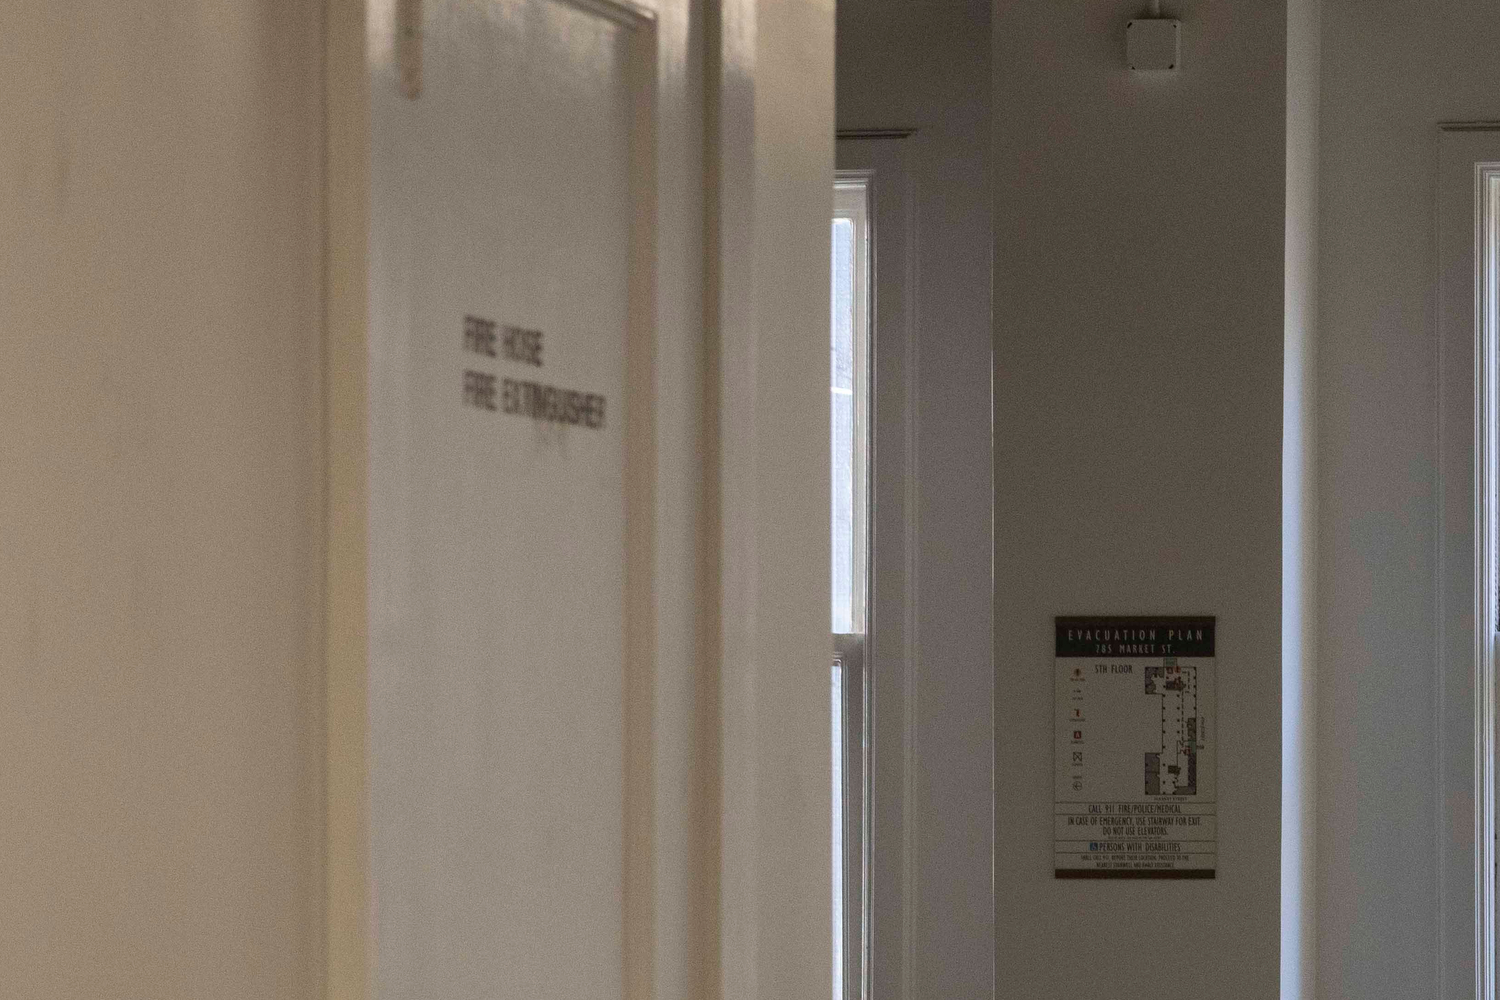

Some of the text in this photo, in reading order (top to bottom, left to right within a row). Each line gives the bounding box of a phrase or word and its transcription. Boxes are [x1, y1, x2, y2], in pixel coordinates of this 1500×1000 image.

[464, 315, 496, 358] FIRE
[463, 370, 606, 429] FIRE EXTINGUISHER
[1068, 629, 1203, 641] EVACUATION PLAN
[1119, 644, 1155, 654] MARKET
[1162, 644, 1176, 654] ST.
[1095, 665, 1133, 674] 5TH FLOOR
[1088, 804, 1182, 813] CALL 911 FIRE/POLICE/MEDICAL
[1068, 817, 1074, 825] IN
[1076, 817, 1088, 825] CASE
[1090, 817, 1097, 825] OF
[1136, 817, 1145, 825] USE
[1147, 817, 1174, 825] STAIRWAY
[1175, 817, 1186, 825] FOR
[1102, 827, 1111, 835] DO
[1113, 827, 1124, 835] NOT
[1125, 827, 1135, 835] USE
[1099, 842, 1181, 851] PERSONS WITH DISABILITIES
